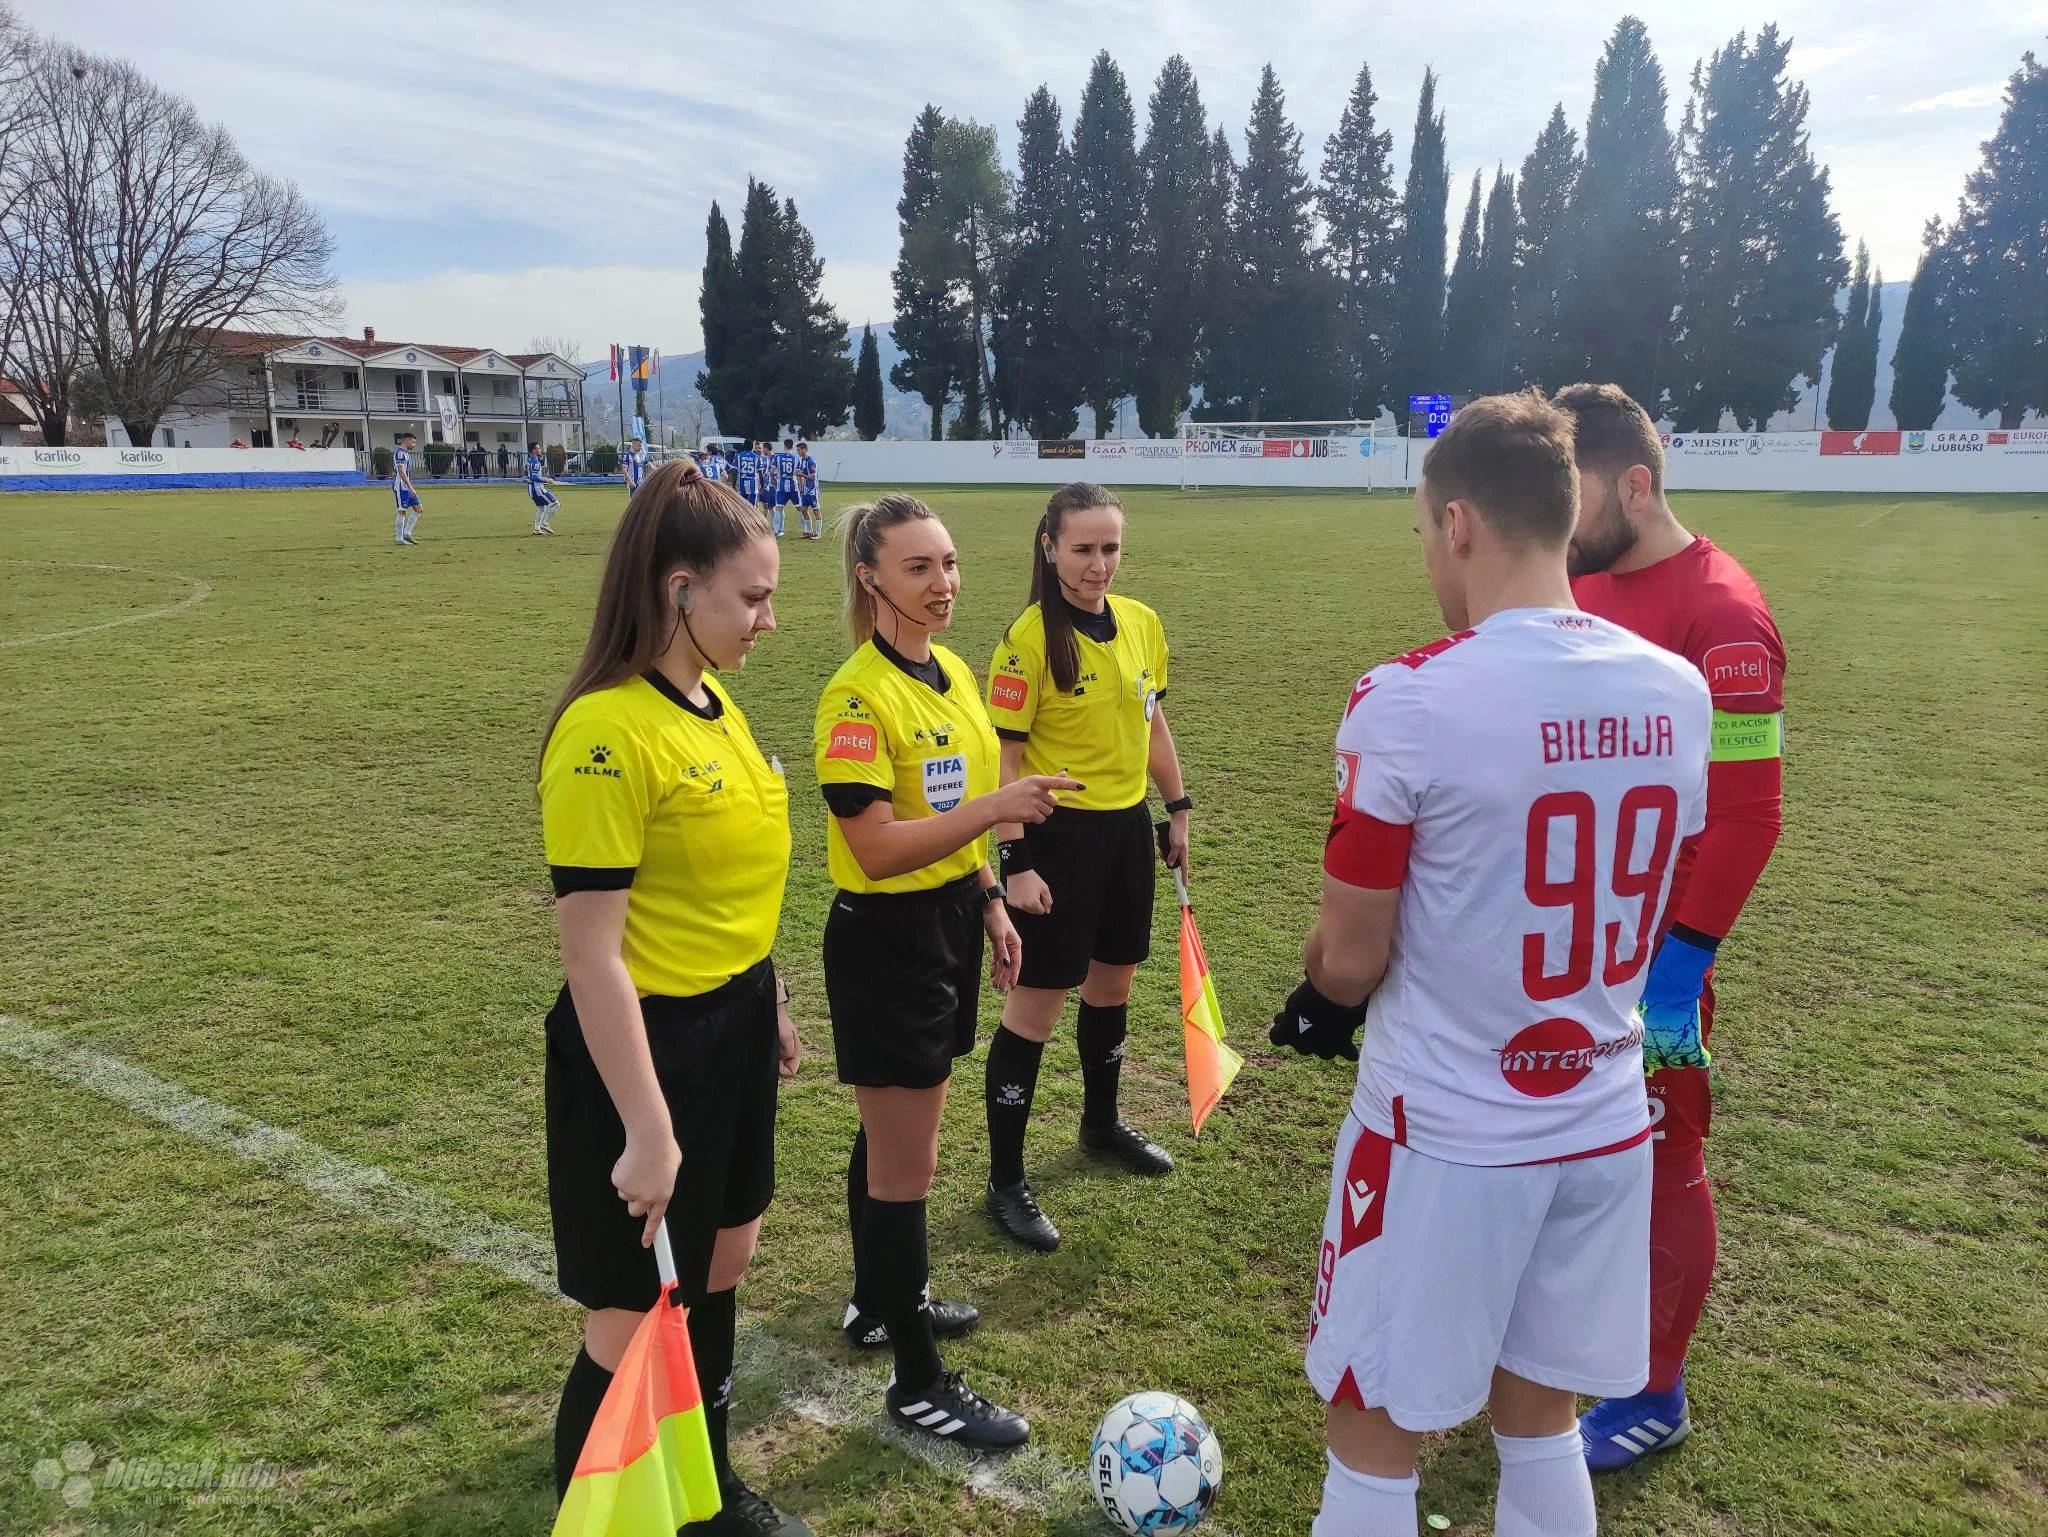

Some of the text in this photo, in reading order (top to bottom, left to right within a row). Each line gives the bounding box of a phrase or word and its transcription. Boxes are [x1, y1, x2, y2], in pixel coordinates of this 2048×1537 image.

[309, 346, 321, 357] G
[406, 352, 417, 363] O
[547, 362, 556, 372] K
[1937, 433, 1979, 441] GRAD
[1310, 439, 1328, 457] JUB
[1931, 441, 1984, 452] LJUBUŠKI
[34, 449, 81, 463] karliko
[121, 450, 163, 463] karliko
[741, 461, 754, 474] 25
[781, 461, 793, 474] 16
[999, 665, 1024, 676] KELME
[1714, 658, 1763, 681] m:tel
[993, 685, 1022, 702] m:tel
[837, 711, 872, 720] KELME
[1731, 718, 1771, 729] RACISM
[833, 735, 872, 751] m:tel
[1540, 715, 1674, 764] BILBIJA
[1720, 734, 1768, 746] RESPECT
[574, 766, 622, 779] KELME
[926, 758, 962, 777] FIFA
[927, 780, 964, 794] REFEREE
[1522, 784, 1678, 1002] 99
[996, 1096, 1026, 1106] KELME
[1099, 1453, 1130, 1529] SELECT
